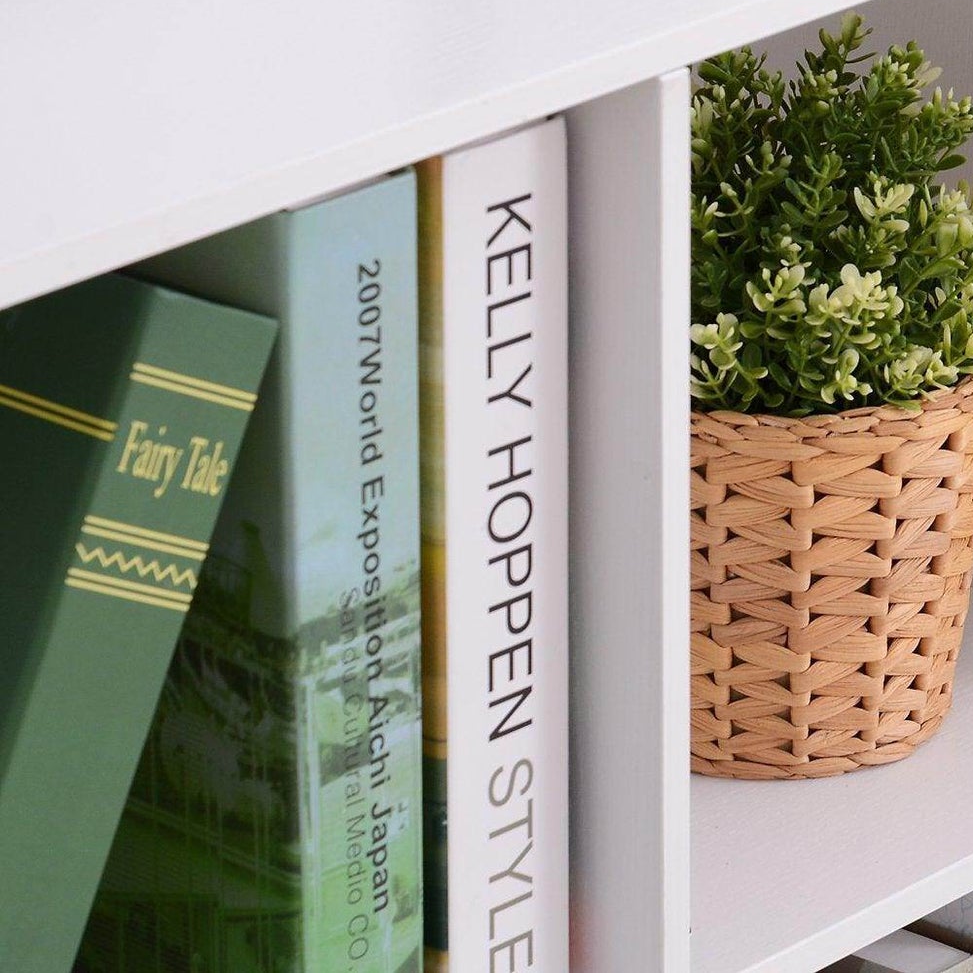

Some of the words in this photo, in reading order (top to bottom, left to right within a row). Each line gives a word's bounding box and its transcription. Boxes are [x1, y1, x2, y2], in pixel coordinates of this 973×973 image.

[486, 192, 533, 408] KELLY
[115, 420, 183, 498] Fairy
[180, 436, 229, 497] Tale
[357, 475, 386, 682] Exposition
[487, 434, 533, 743] HOPPEN
[366, 695, 391, 790] Aichi
[366, 801, 394, 914] Japan
[488, 757, 534, 973] STYLE
